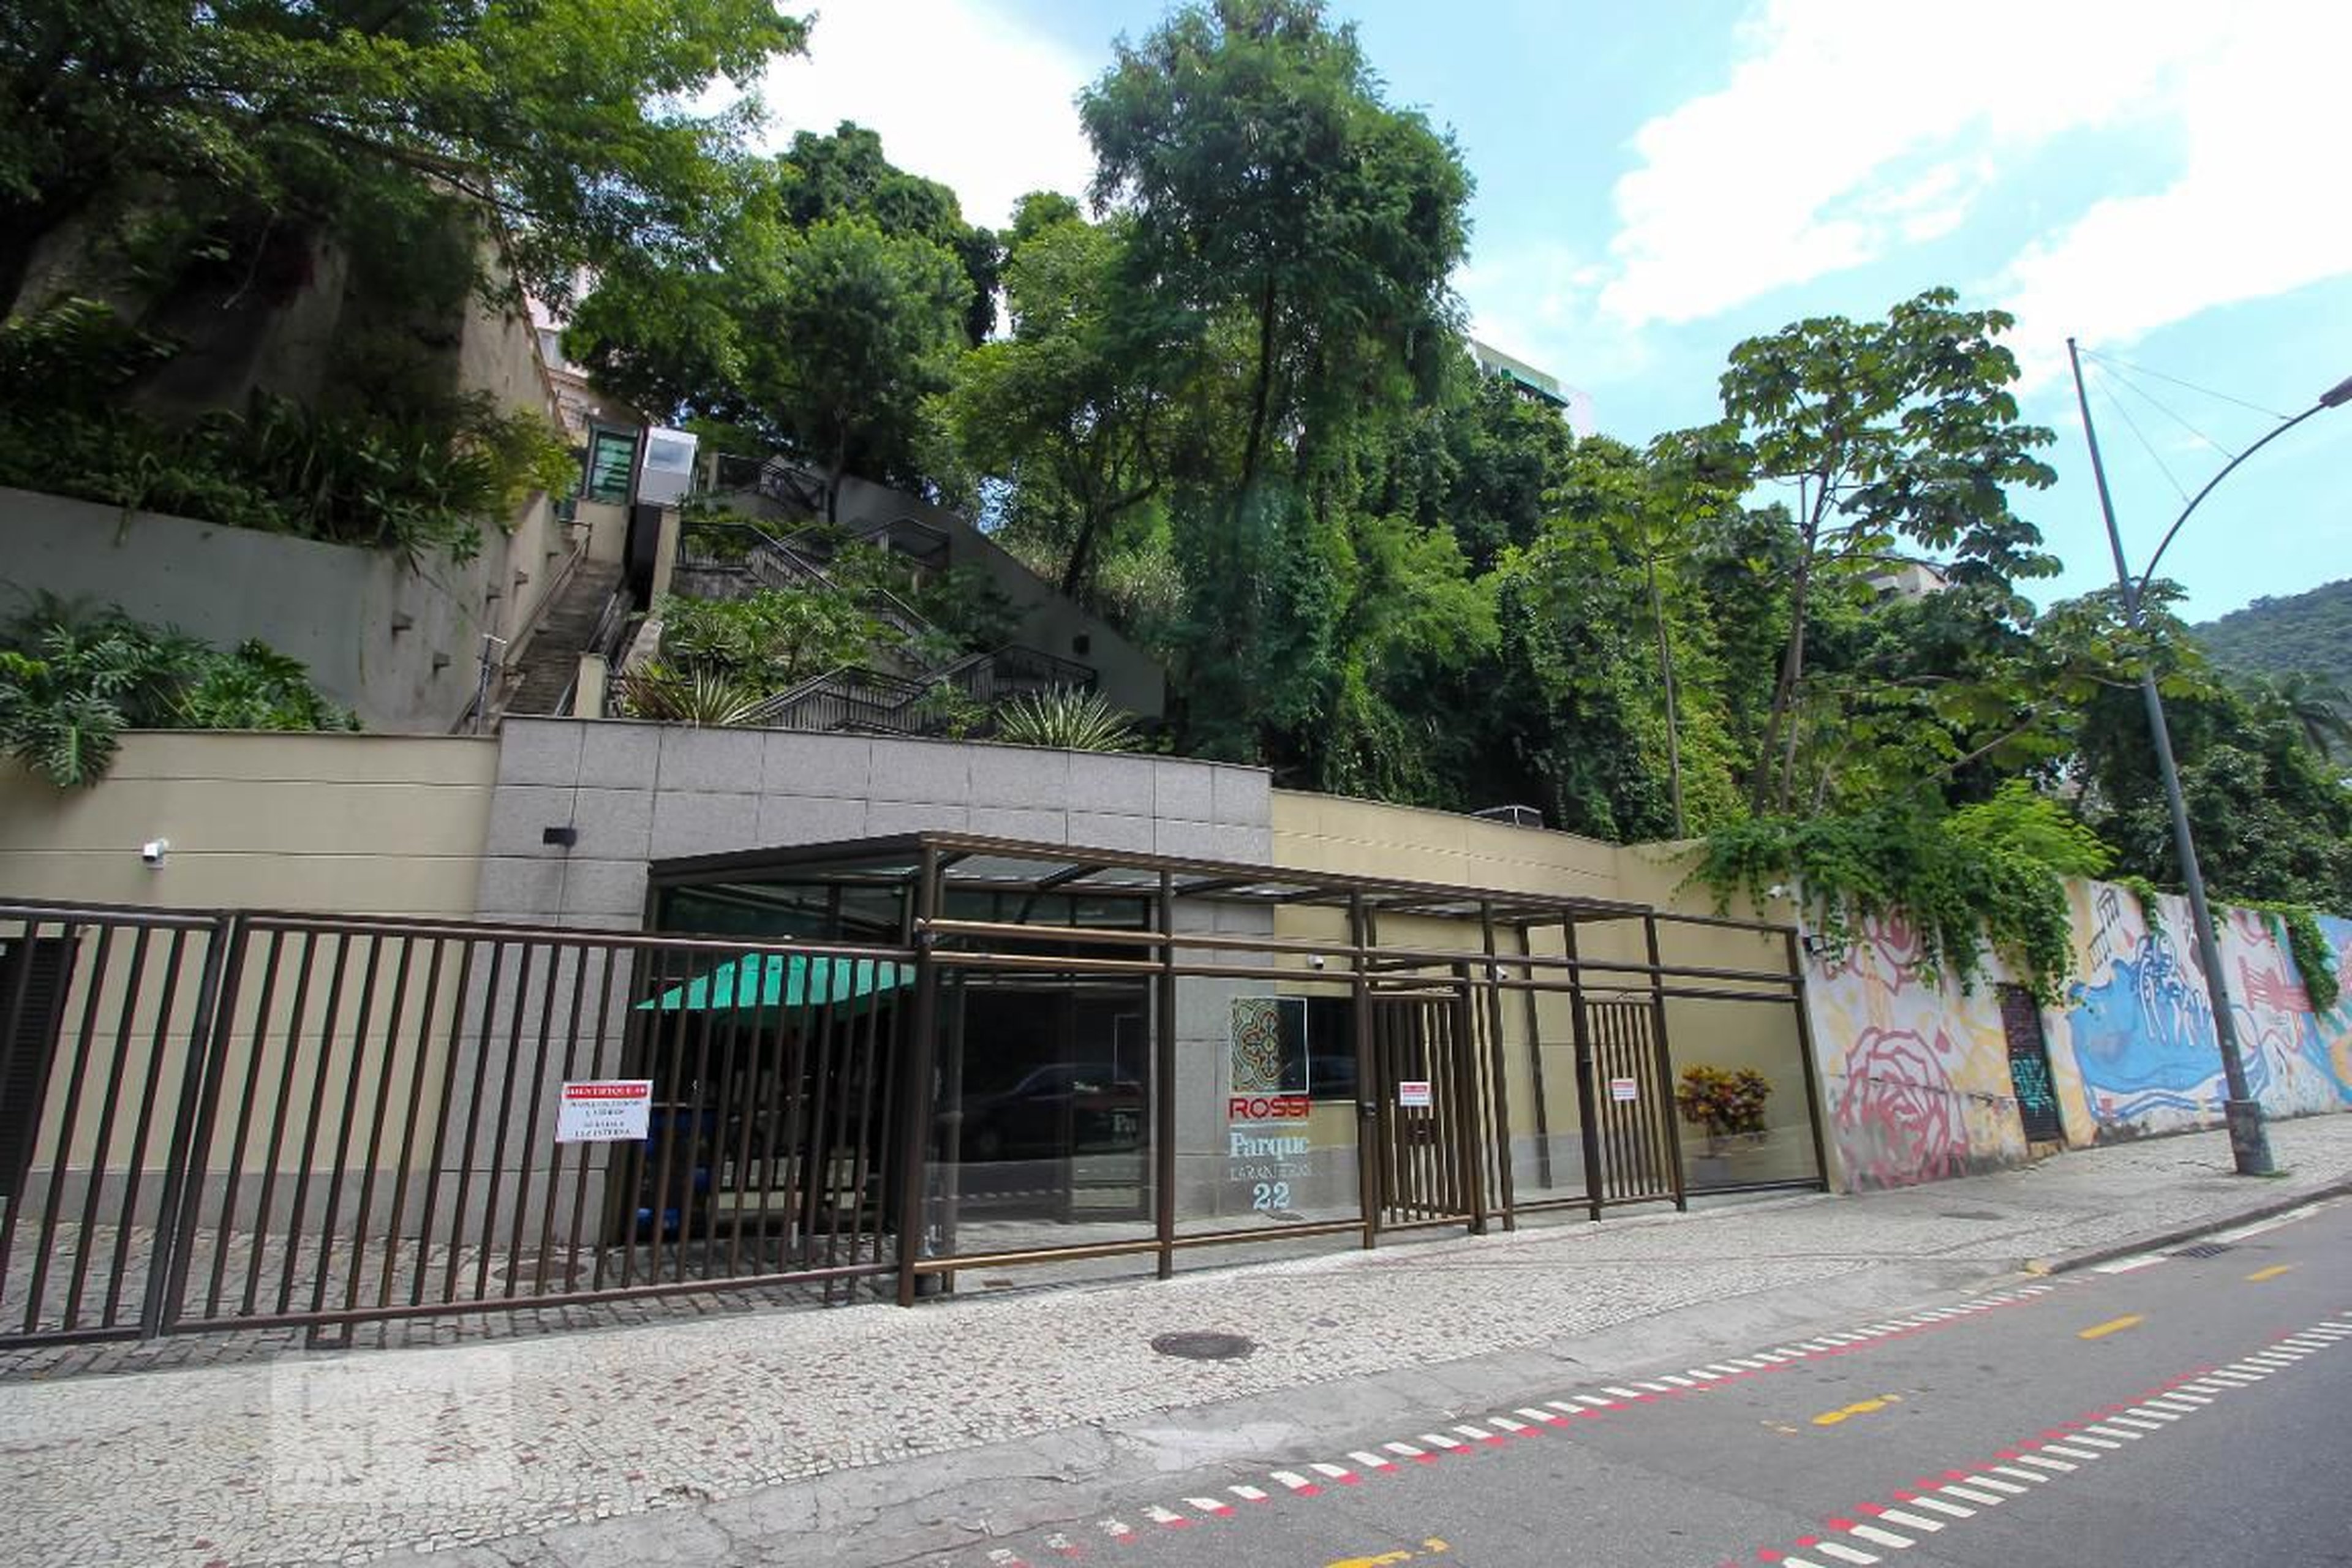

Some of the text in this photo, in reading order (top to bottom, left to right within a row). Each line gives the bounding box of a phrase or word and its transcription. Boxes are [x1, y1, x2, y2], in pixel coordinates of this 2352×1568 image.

[1229, 1098, 1310, 1119] ROSSI
[1229, 1132, 1309, 1161] Parque
[1254, 1182, 1291, 1210] 22
